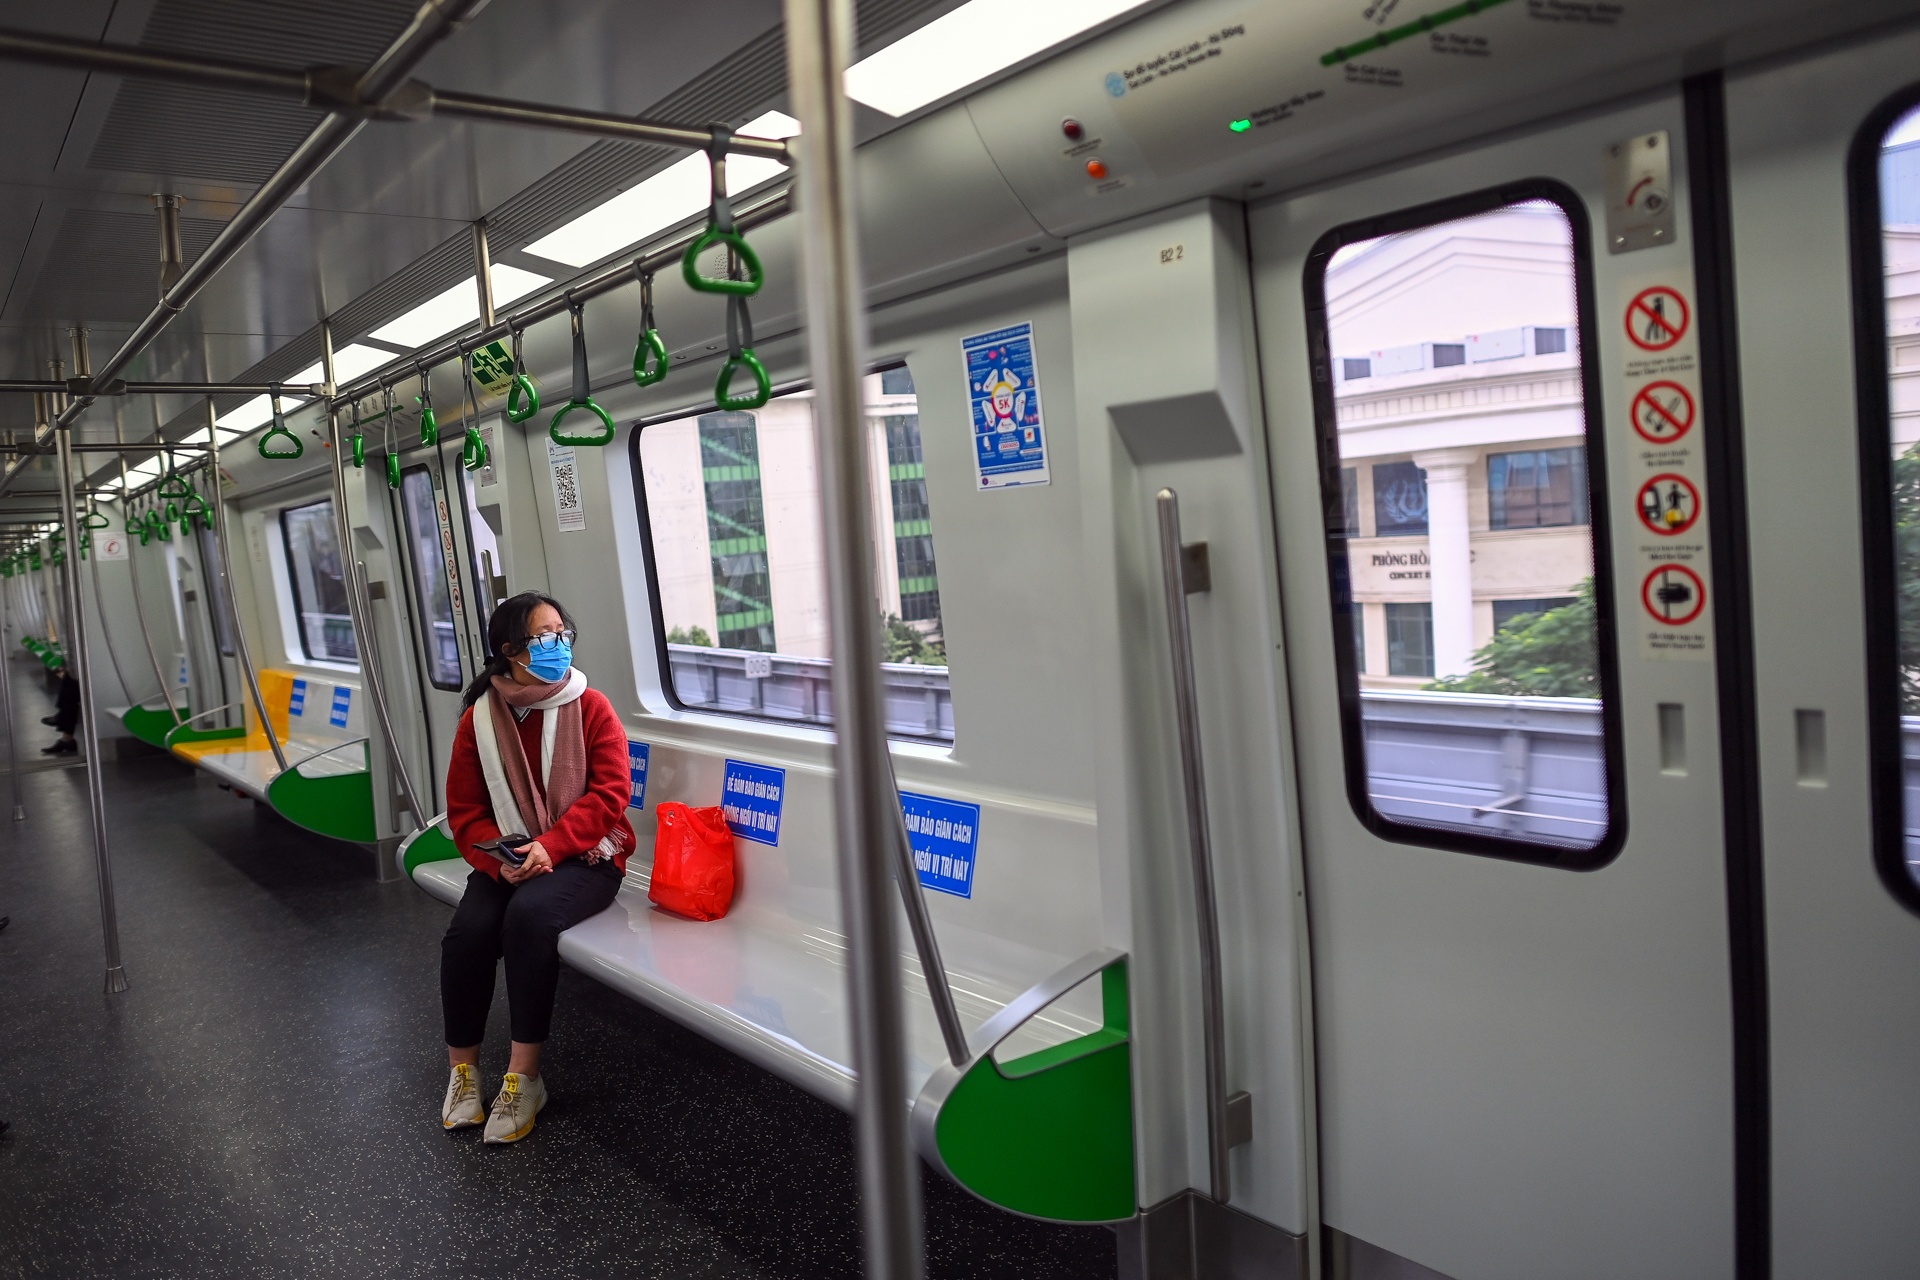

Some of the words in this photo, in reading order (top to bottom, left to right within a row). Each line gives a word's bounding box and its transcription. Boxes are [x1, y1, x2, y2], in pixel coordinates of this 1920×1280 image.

[998, 397, 1010, 410] 5K
[1372, 550, 1408, 566] PHÒNG
[1389, 571, 1423, 580] CONCERT
[750, 659, 767, 673] 006
[744, 775, 755, 796] BẢO
[766, 782, 780, 802] CÁCH
[765, 811, 778, 833] NÀY
[920, 810, 934, 836] BẢO
[934, 817, 952, 840] GIÃN
[952, 820, 972, 844] CÁCH
[931, 853, 940, 880] VỊ
[940, 853, 954, 878] TRÍ
[952, 856, 969, 882] NÀY
